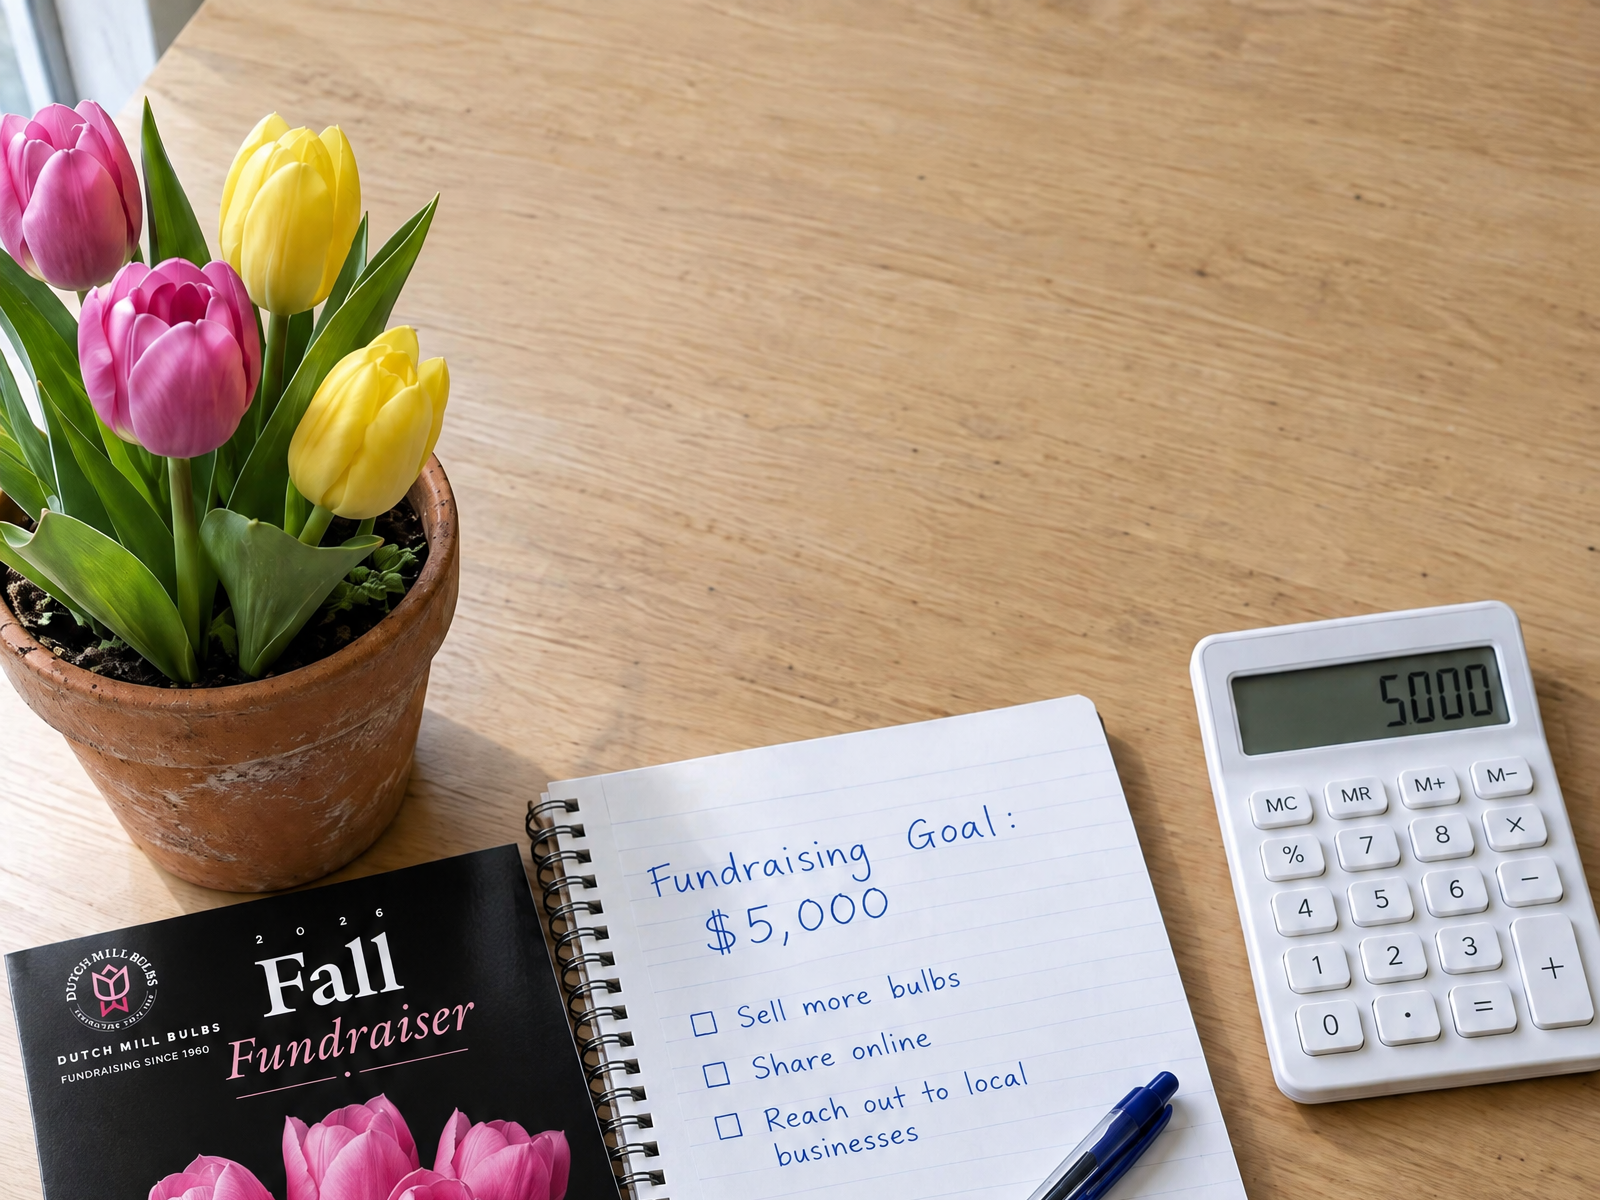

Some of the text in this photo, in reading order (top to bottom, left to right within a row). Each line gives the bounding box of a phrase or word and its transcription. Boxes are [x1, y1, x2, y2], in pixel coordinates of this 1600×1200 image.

[1414, 774, 1446, 794] M+
[1265, 795, 1299, 813] MC
[1340, 786, 1372, 804] MR
[1358, 835, 1374, 854] 7
[1434, 824, 1451, 844] 8
[646, 804, 1016, 898] Fundraising Goal:
[1374, 889, 1389, 909] 5
[1449, 879, 1464, 899] 6
[1297, 898, 1313, 918] 4
[705, 887, 889, 956] $5,000
[91, 948, 128, 962] MILL
[1387, 945, 1403, 966] 2
[1462, 936, 1478, 956] 3
[254, 931, 404, 1018] Fall
[1311, 955, 1323, 975] 1
[736, 967, 962, 1029] Sell more bulbs
[1323, 1014, 1340, 1035] 0
[57, 1022, 220, 1065] DUTCH MILL BULBS
[225, 1001, 475, 1081] Fundraiser
[61, 1045, 210, 1084] FUNDRAISING SINCE 1960
[751, 1030, 933, 1080] Share online
[763, 1061, 1029, 1133] Reach out to local
[774, 1124, 920, 1167] businesses
